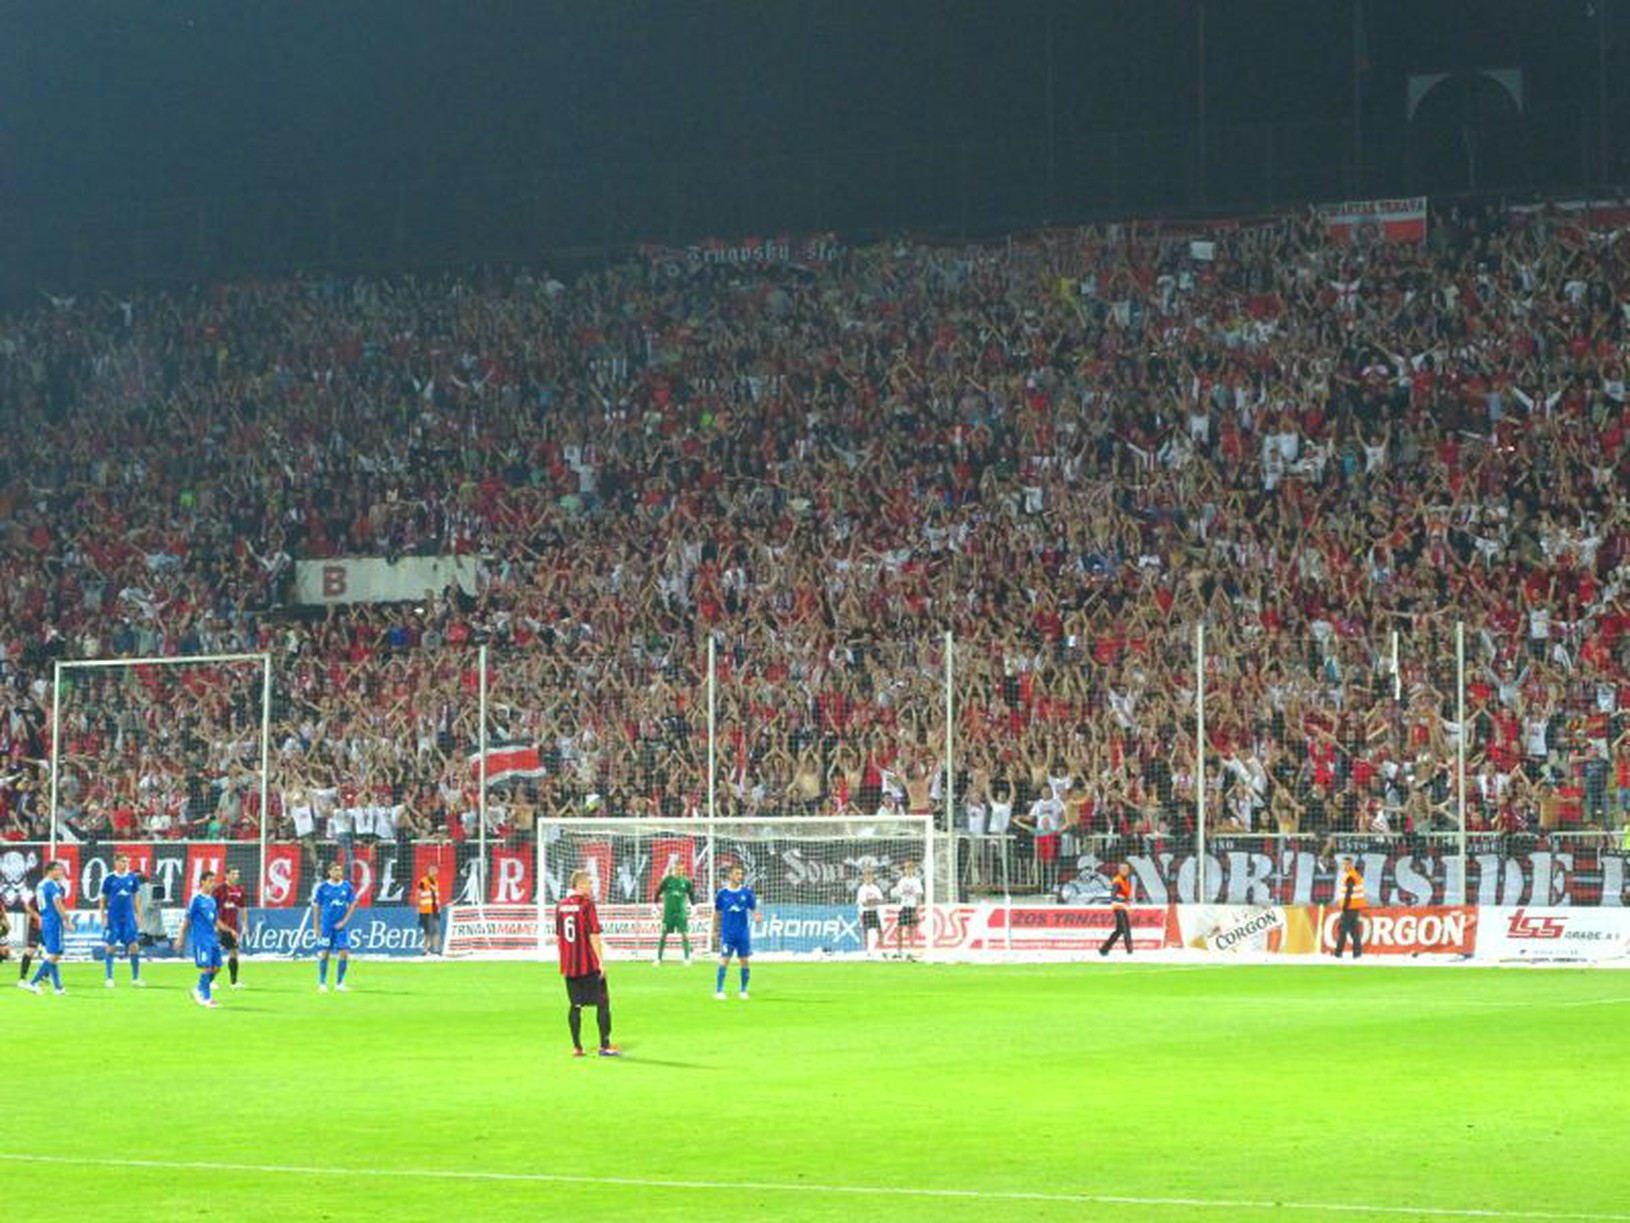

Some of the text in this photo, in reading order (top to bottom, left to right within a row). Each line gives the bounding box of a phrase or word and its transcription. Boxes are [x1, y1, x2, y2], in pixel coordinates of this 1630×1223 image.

[323, 566, 346, 597] B
[239, 920, 430, 950] Merces-Benz
[565, 915, 577, 943] 6
